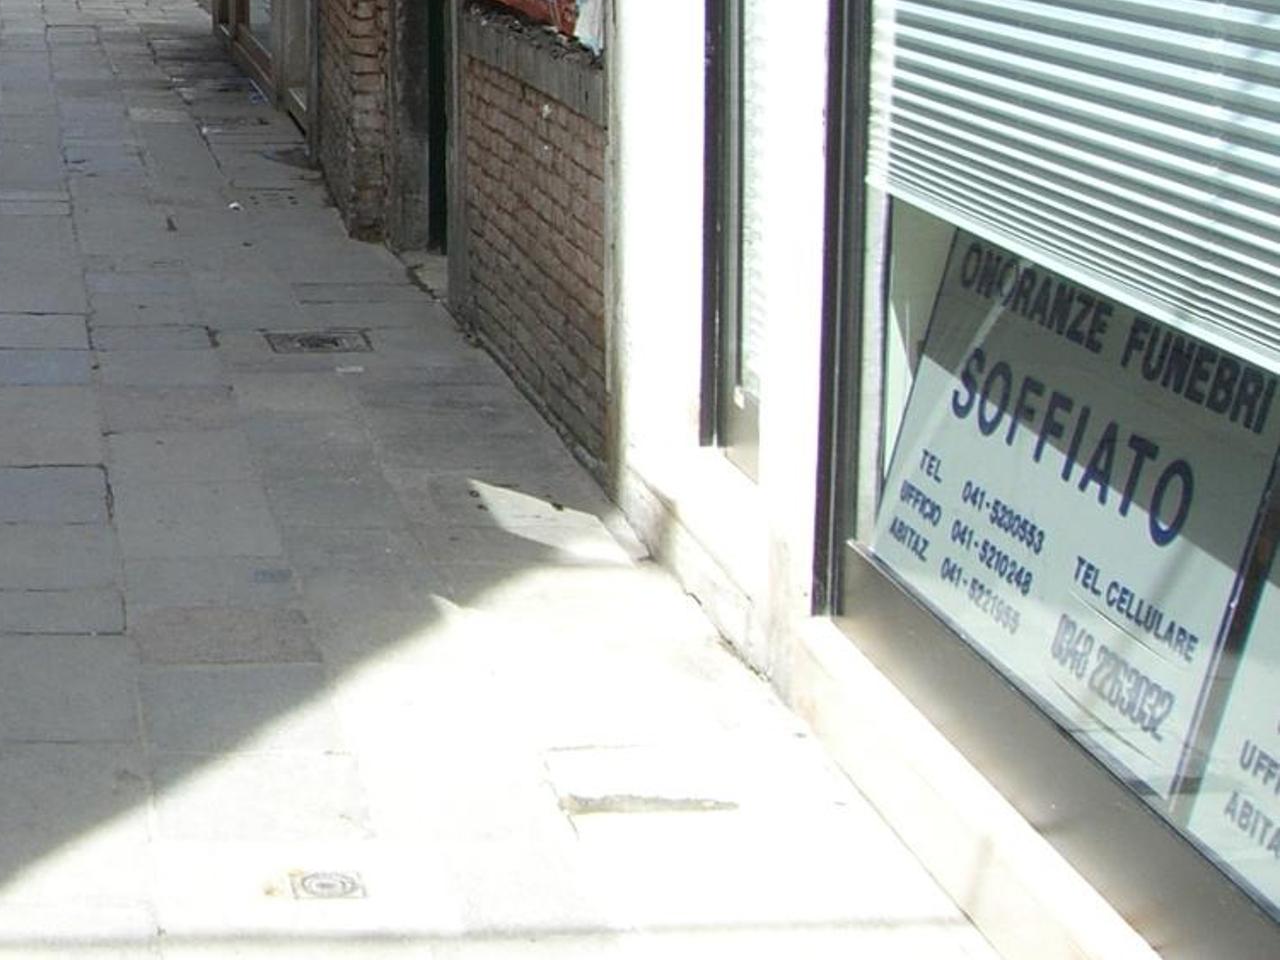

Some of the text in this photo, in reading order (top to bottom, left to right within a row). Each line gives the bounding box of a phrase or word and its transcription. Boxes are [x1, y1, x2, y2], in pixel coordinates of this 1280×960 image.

[960, 243, 1279, 434] ONORANZE FUNEBRI
[951, 347, 1194, 547] SOFFIATO
[900, 479, 1033, 596] UFFICIO 041-5210248
[1106, 581, 1199, 662] CELLULARE
